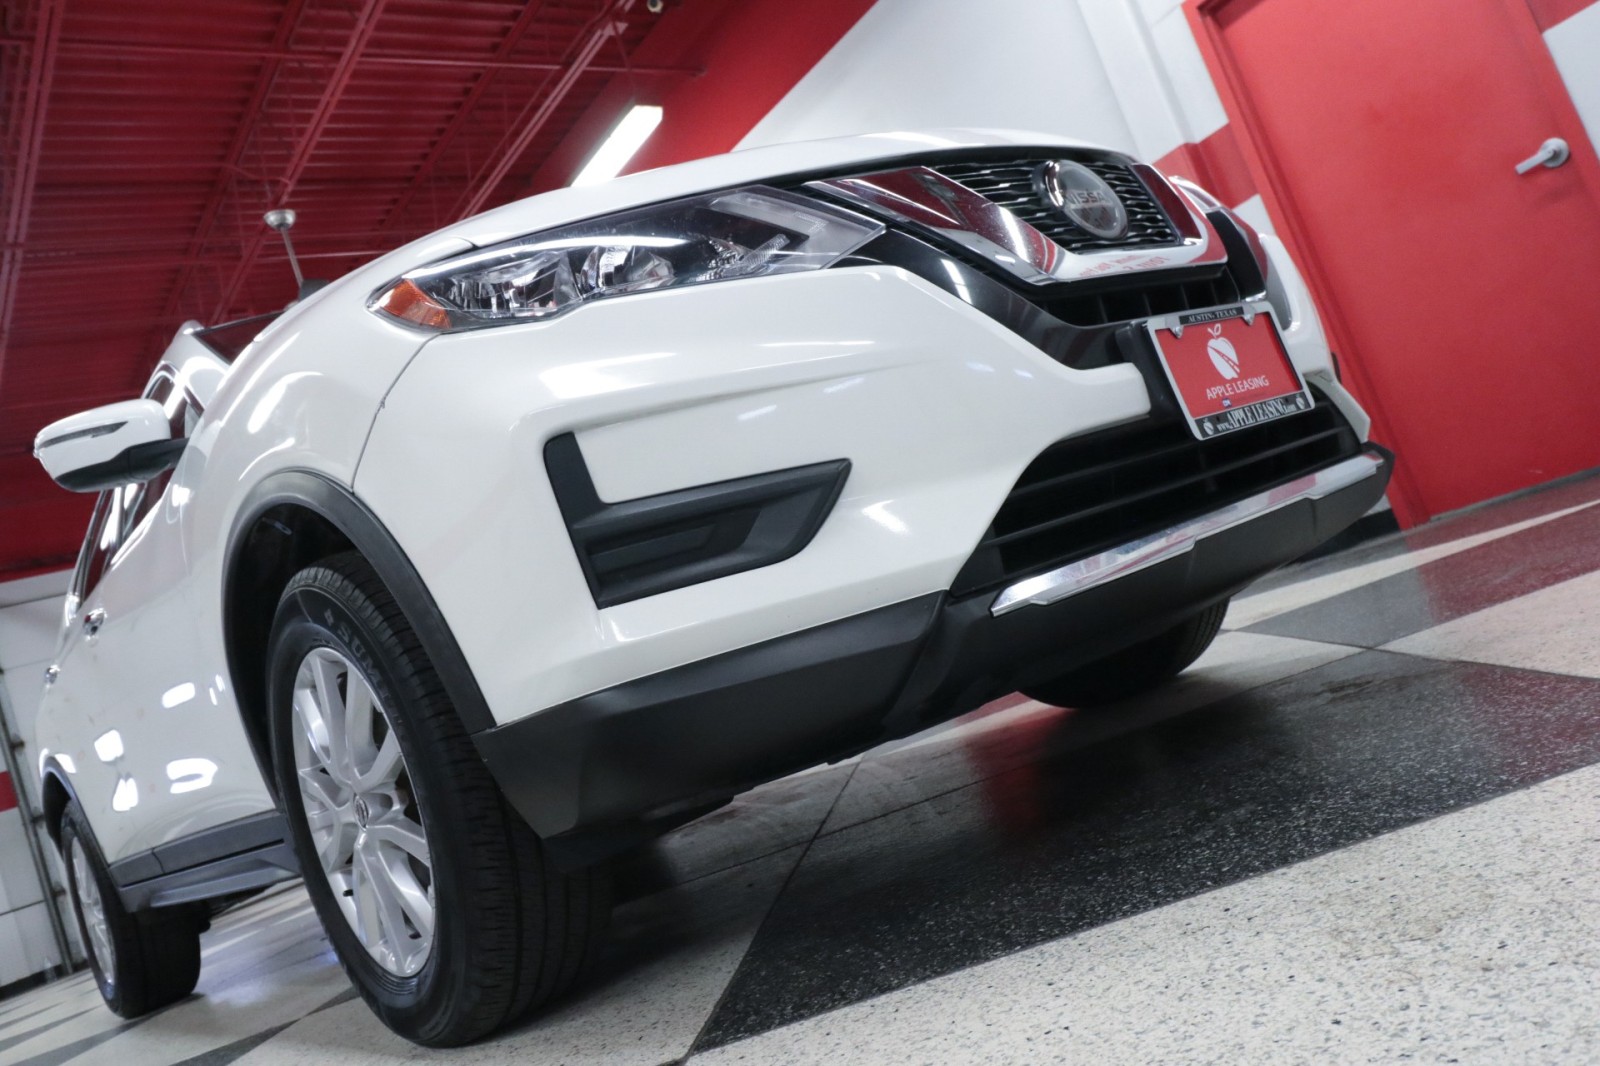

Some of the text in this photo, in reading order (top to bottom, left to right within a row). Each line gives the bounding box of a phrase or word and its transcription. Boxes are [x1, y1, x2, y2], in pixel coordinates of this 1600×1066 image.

[1215, 309, 1238, 319] TEXAS
[1206, 375, 1270, 400] APPLE LEASING
